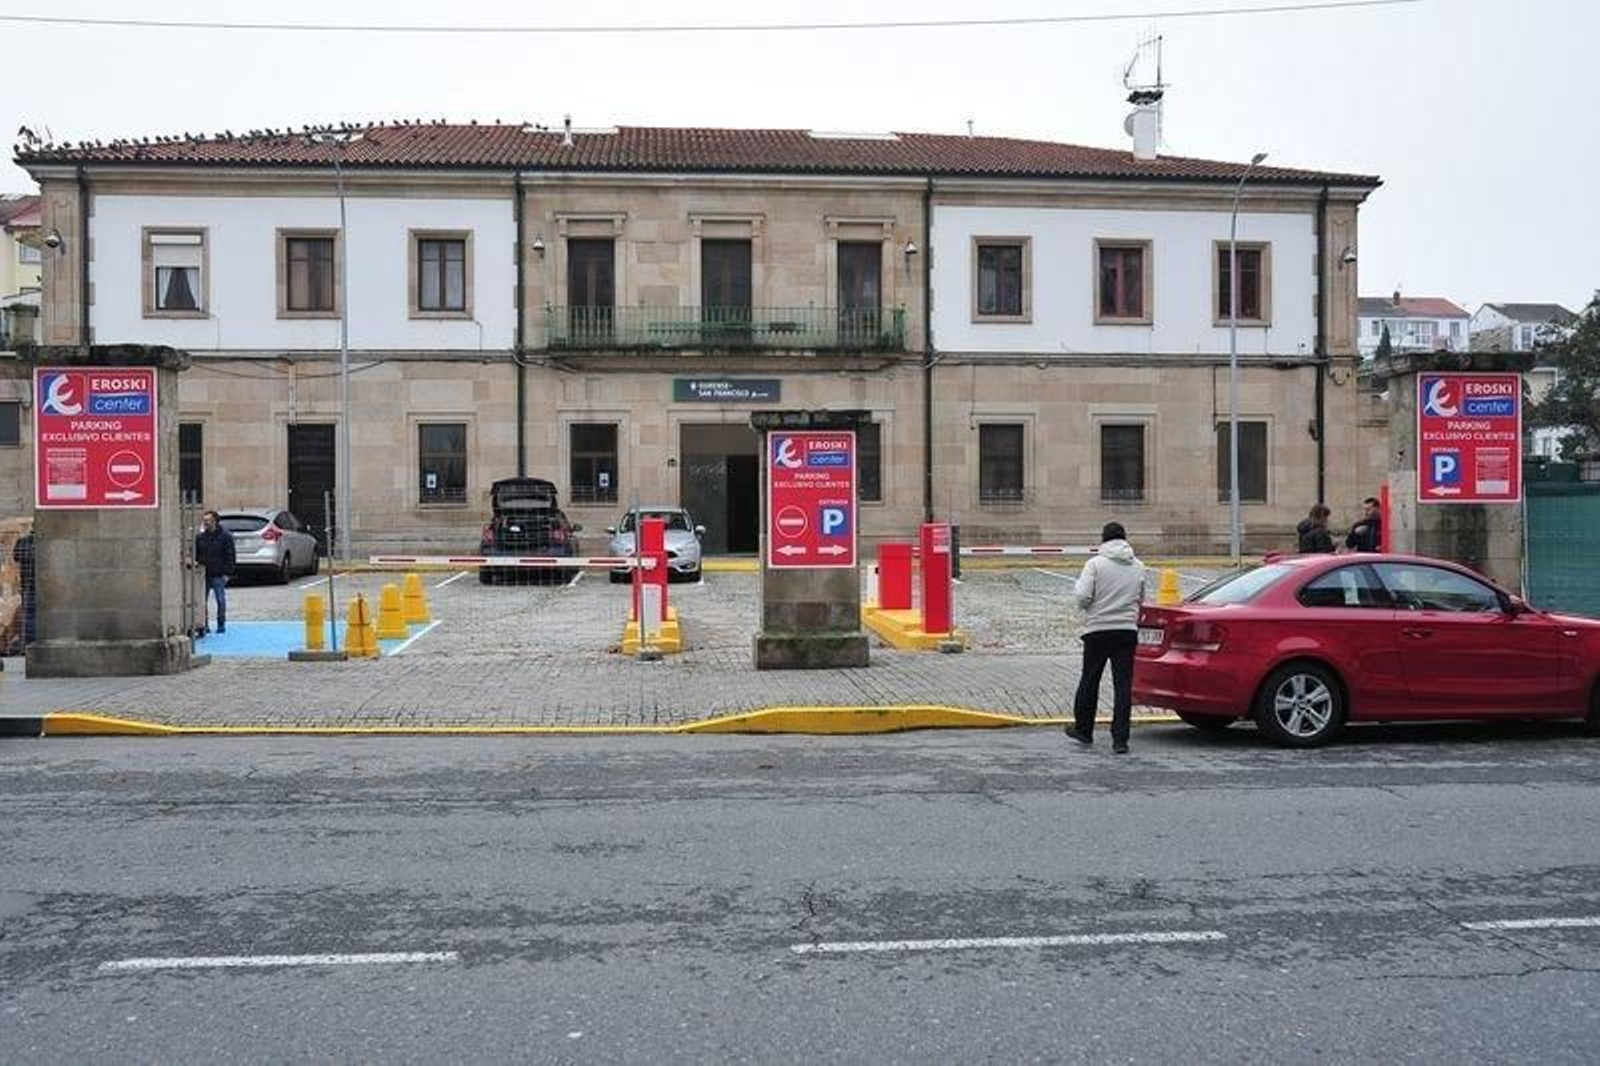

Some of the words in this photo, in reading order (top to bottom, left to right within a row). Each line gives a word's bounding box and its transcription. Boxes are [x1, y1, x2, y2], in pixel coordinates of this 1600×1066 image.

[91, 378, 147, 390] EROSKI
[1465, 383, 1512, 394] EROSKI
[94, 398, 143, 410] center
[1467, 401, 1509, 413] center
[70, 421, 123, 431] PARKING
[1446, 421, 1491, 430] PARKING
[42, 432, 100, 441] EXCLUSIVO
[101, 432, 152, 441] CLIENTES
[1423, 432, 1472, 440] EXCLUSIVO
[1473, 432, 1516, 440] CLIENTES
[808, 441, 847, 450] EROSKI
[1434, 455, 1456, 482] P
[794, 472, 831, 480] PARKING
[822, 508, 845, 535] P
